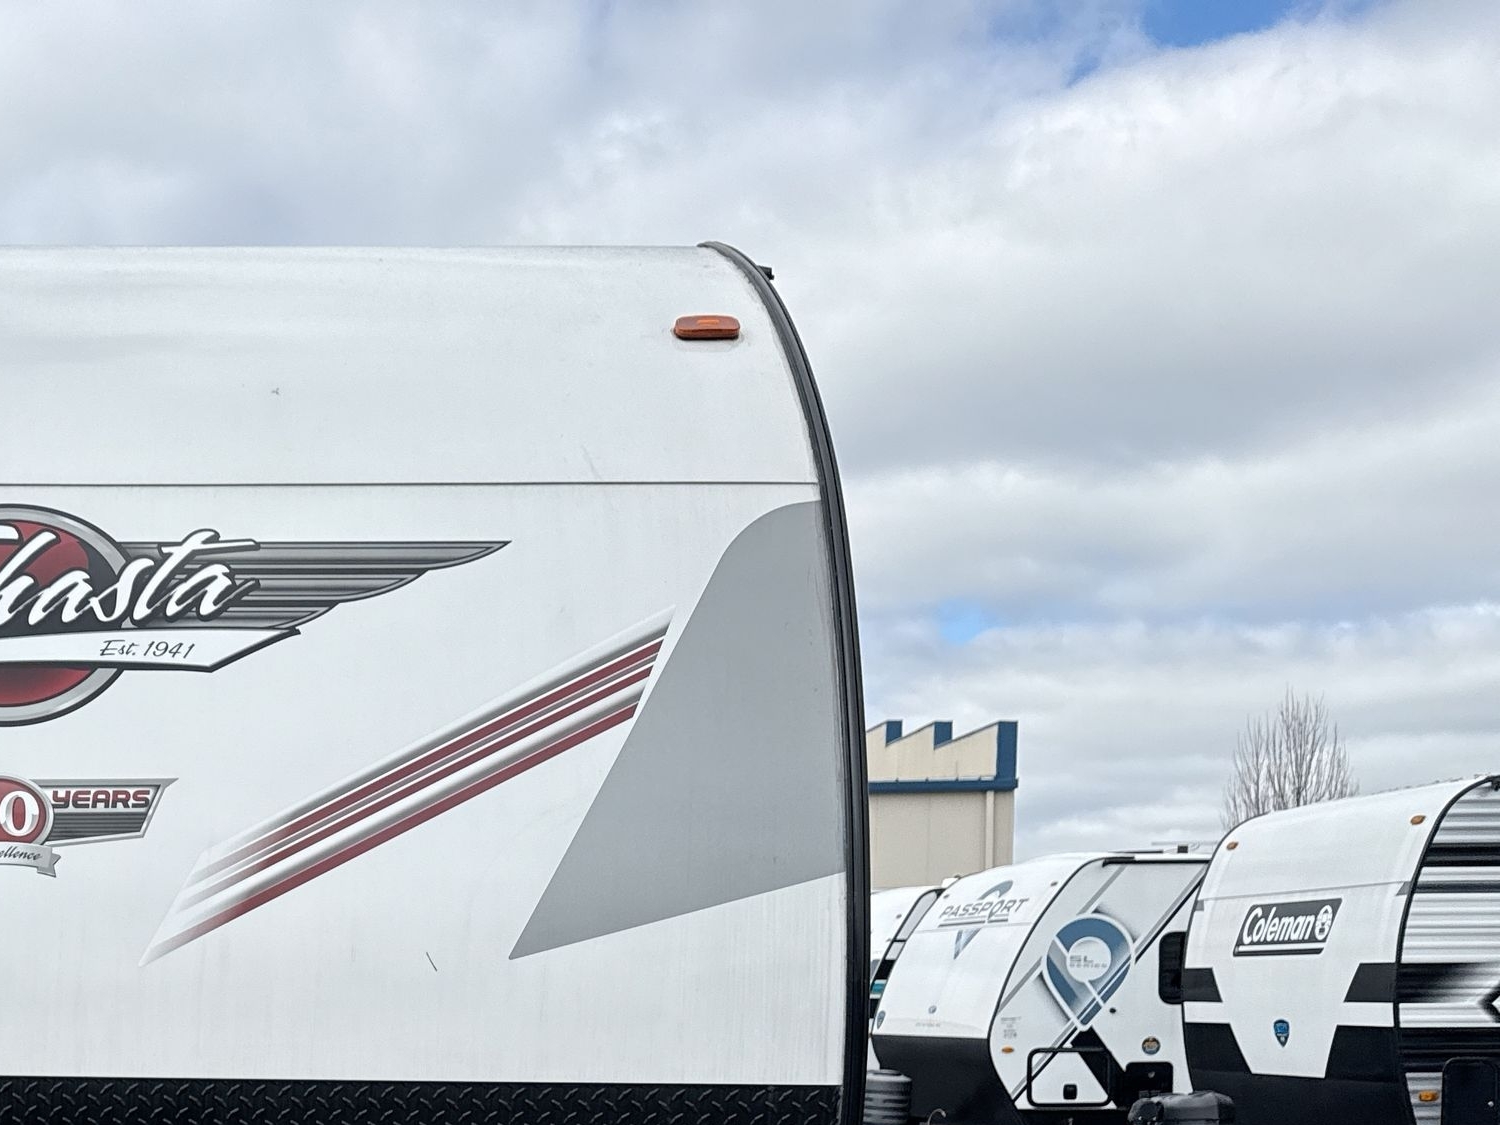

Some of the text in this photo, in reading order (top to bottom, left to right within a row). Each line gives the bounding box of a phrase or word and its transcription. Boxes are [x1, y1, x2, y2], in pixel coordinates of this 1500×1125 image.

[99, 639, 196, 659] Est. 1941
[51, 789, 151, 809] YEARS
[939, 898, 1030, 920] PASSPORT
[1242, 906, 1316, 945] Coleman
